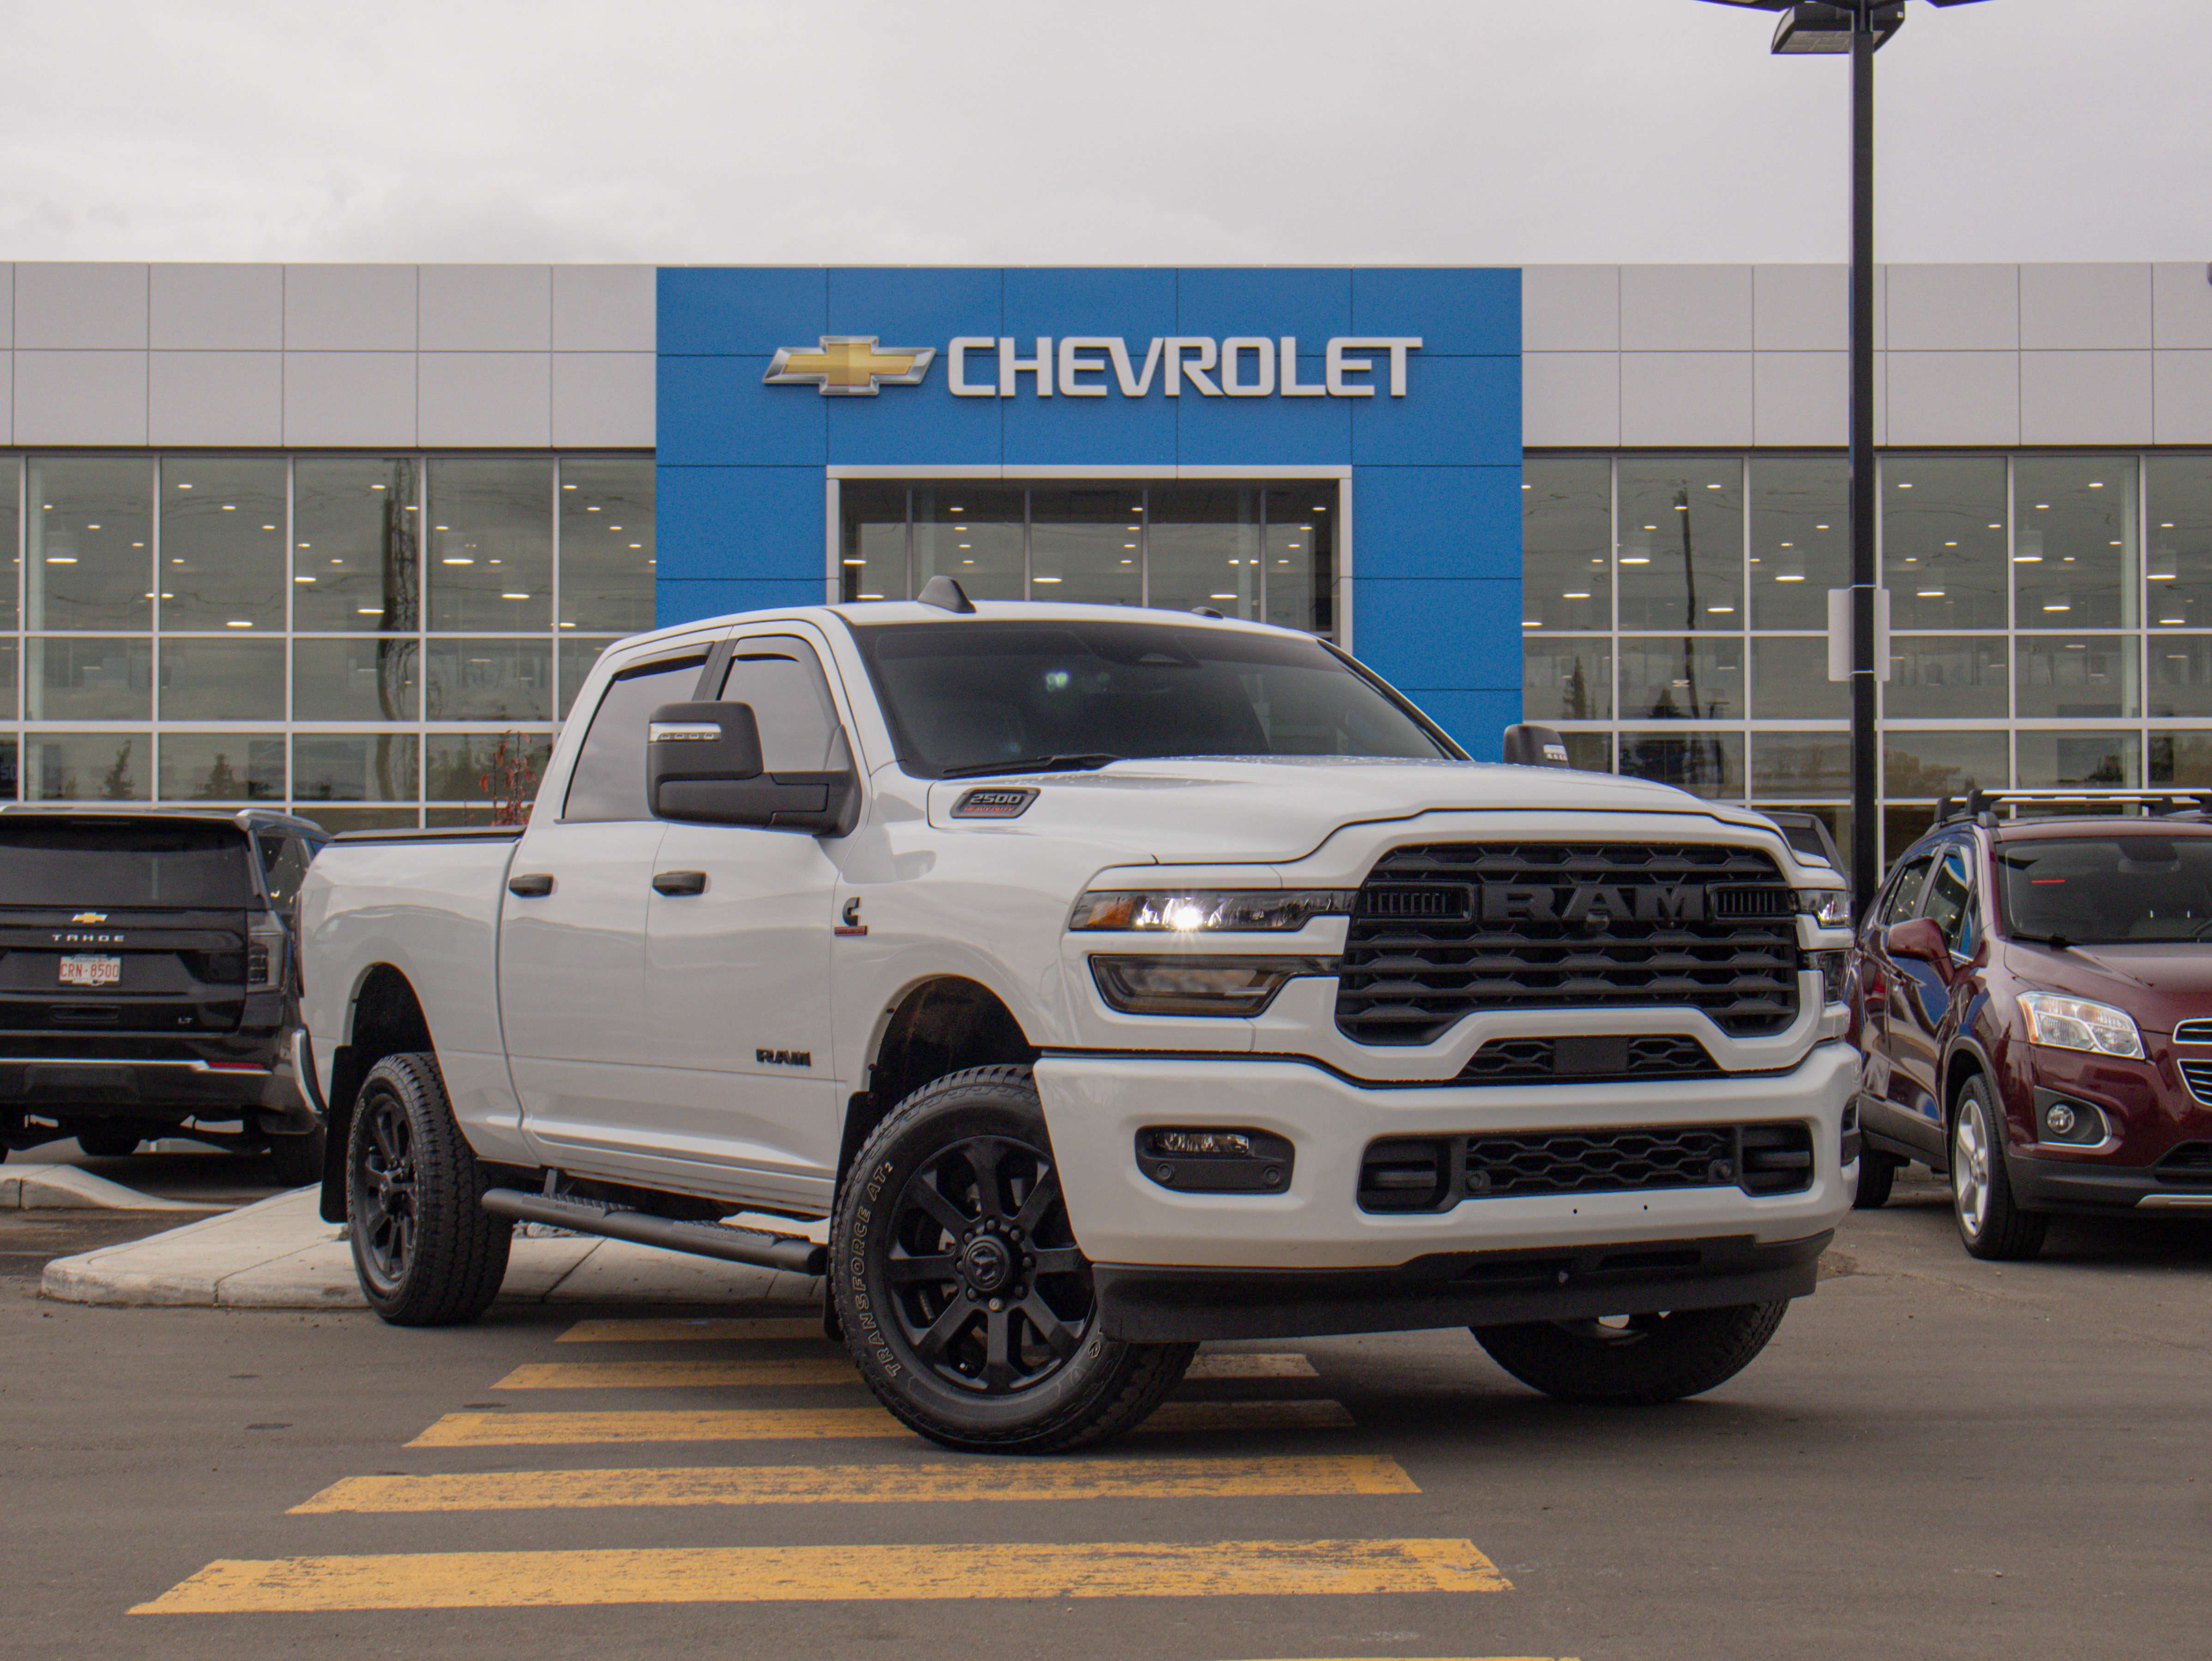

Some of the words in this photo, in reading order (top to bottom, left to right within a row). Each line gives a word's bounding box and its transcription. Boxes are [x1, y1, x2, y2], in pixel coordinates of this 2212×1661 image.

[948, 337, 1422, 396] CHEVROLET
[971, 794, 1021, 804] 2500
[1482, 884, 1705, 921] RAM
[52, 934, 124, 942] TAHOE
[60, 963, 119, 977] CRN-8500
[756, 1049, 811, 1066] RAM
[851, 1206, 901, 1377] TRANSFORCE
